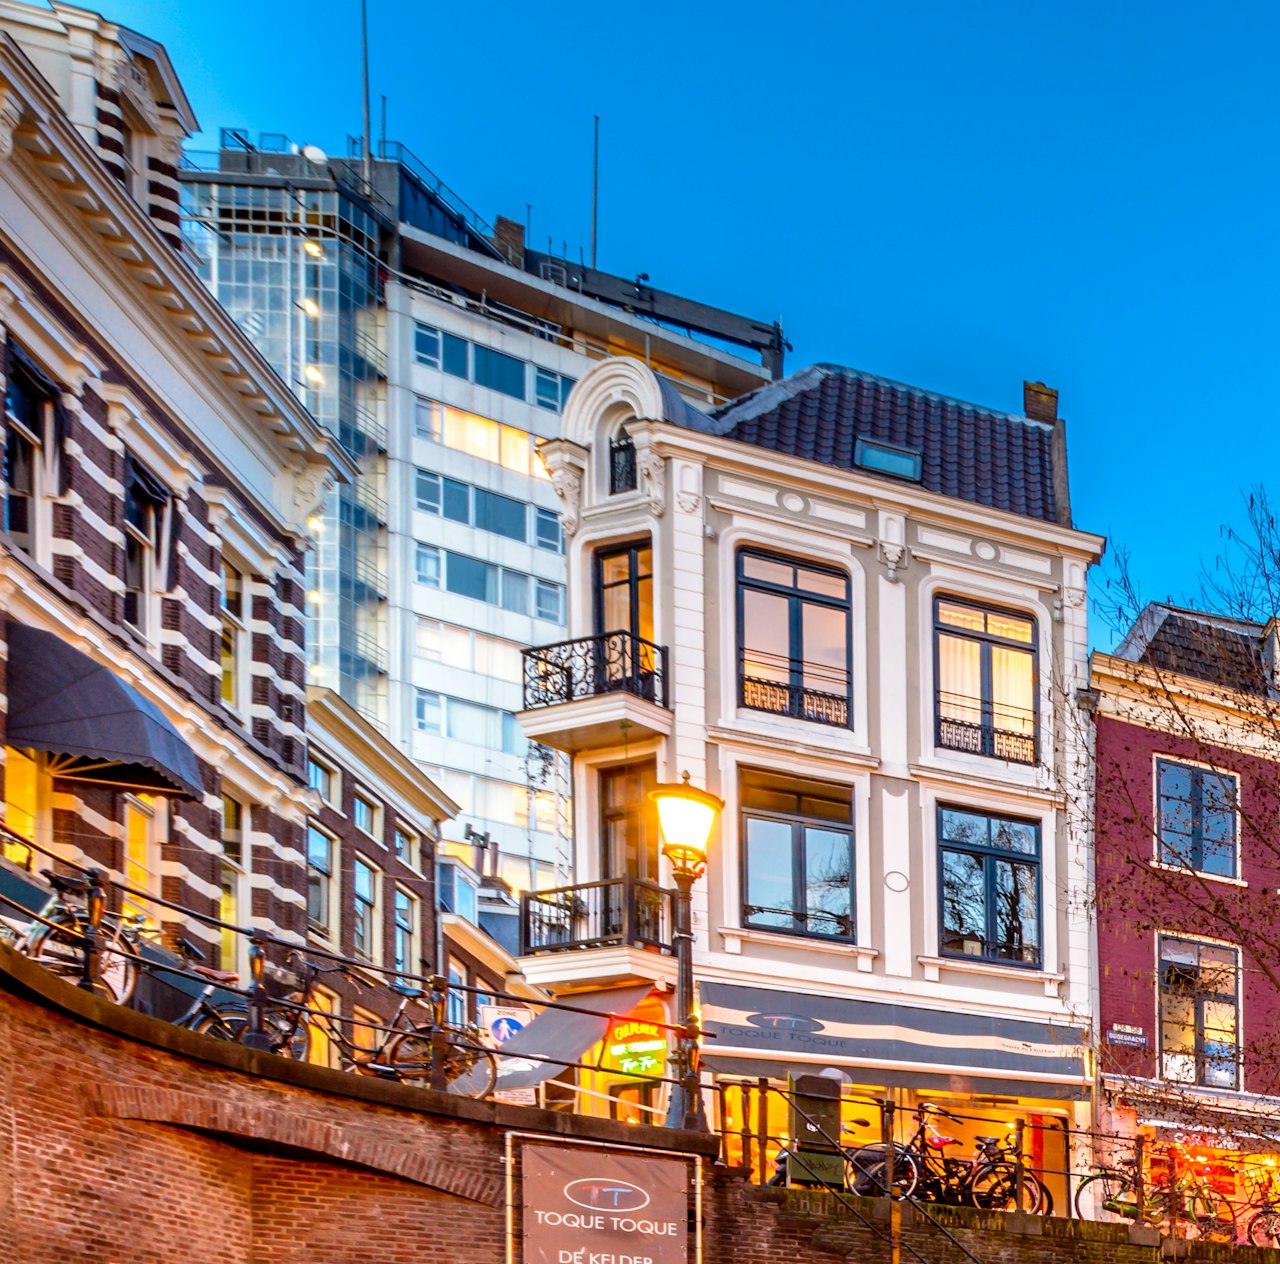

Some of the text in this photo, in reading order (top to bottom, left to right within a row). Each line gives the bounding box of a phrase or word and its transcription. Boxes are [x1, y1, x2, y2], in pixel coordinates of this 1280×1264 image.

[719, 1026, 849, 1049] TOQUE TOQUE
[1108, 1032, 1147, 1044] OUDEGRACHT
[534, 1210, 678, 1236] TOQUE TOQUE
